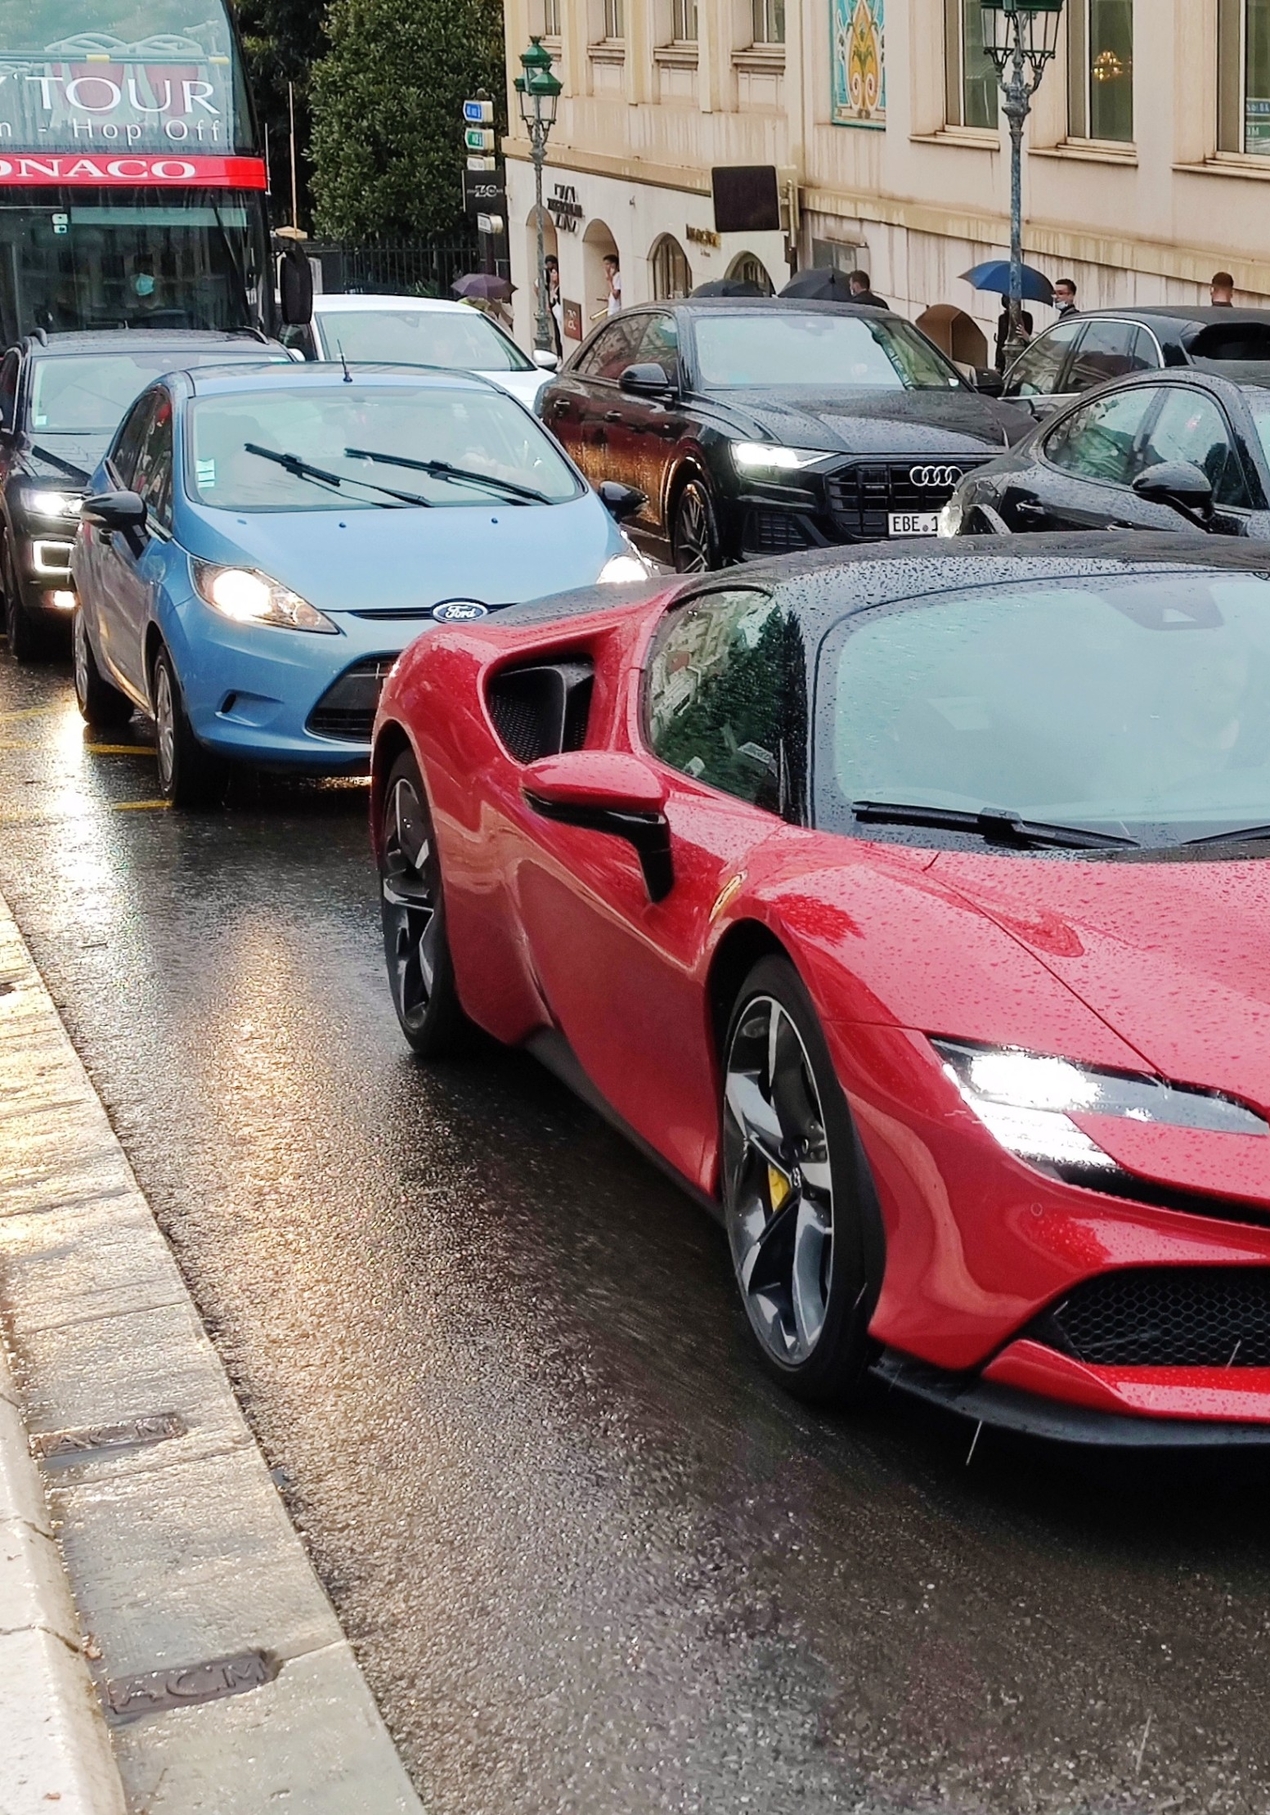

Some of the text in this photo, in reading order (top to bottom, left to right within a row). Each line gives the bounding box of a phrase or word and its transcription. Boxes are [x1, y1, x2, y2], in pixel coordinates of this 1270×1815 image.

[72, 118, 142, 146] Hop
[165, 119, 219, 142] Off
[0, 158, 196, 179] NACO
[893, 515, 920, 532] EBE
[445, 605, 477, 618] Ford
